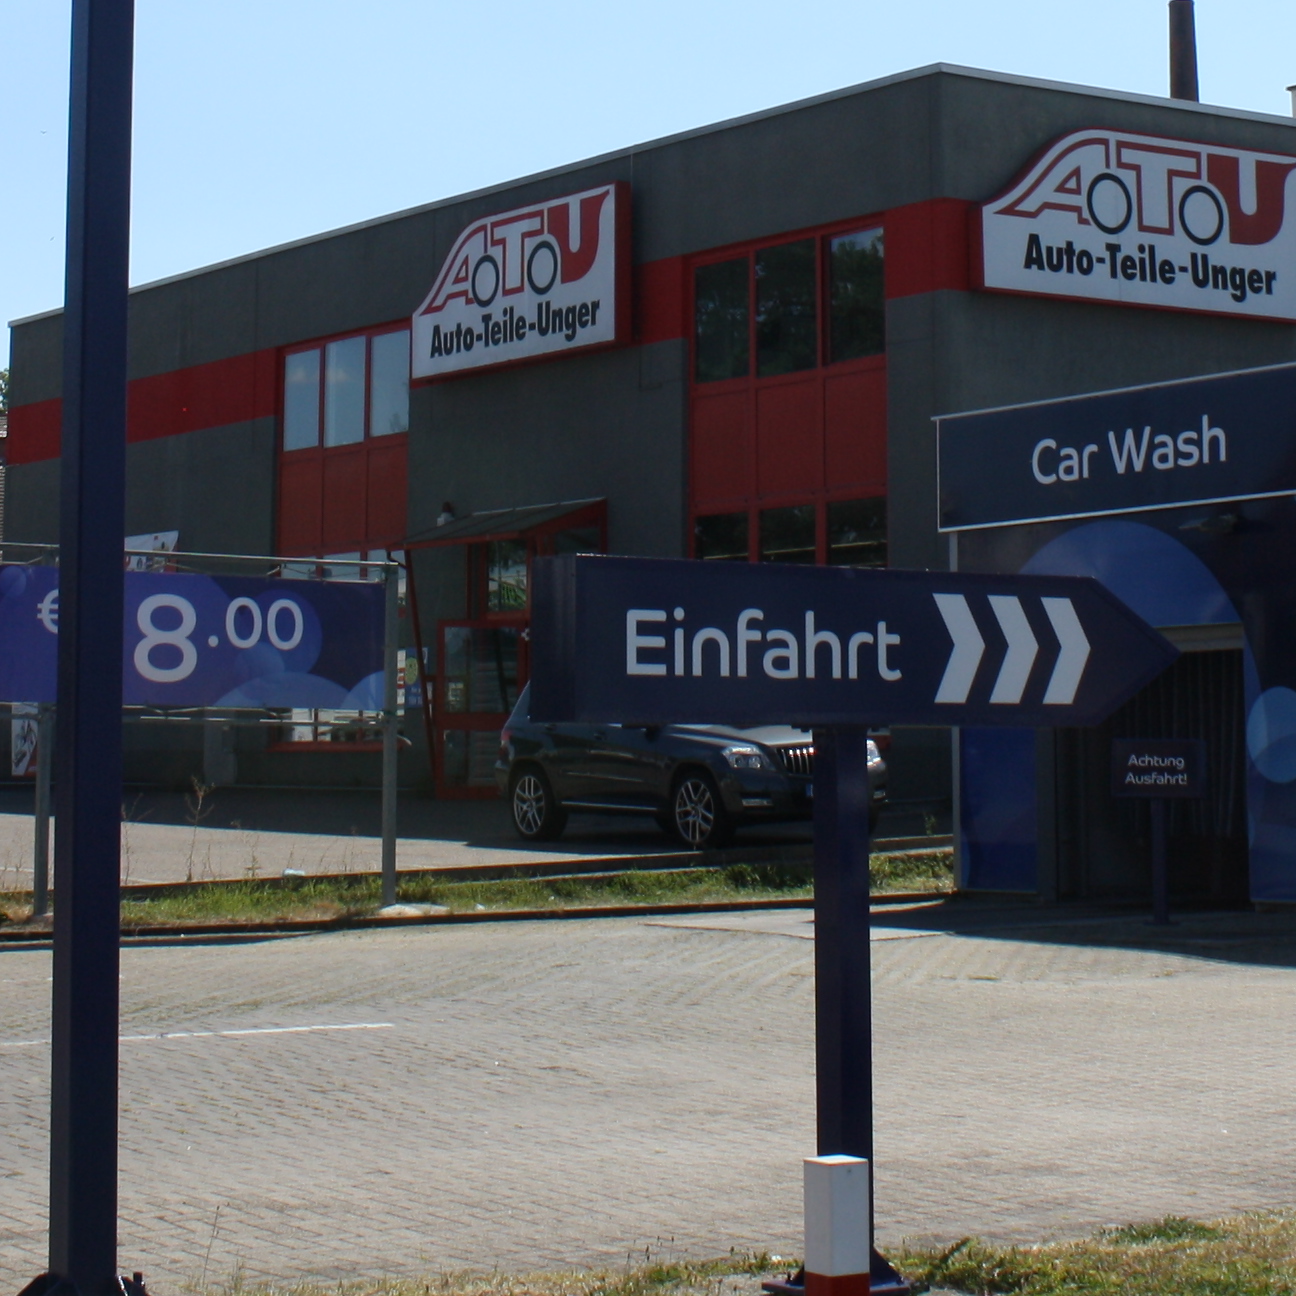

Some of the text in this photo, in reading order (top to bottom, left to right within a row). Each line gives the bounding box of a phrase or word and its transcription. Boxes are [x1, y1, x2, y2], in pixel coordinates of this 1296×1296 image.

[419, 188, 611, 317] ATU
[1023, 233, 1277, 303] Auto-Teile-Unger
[429, 299, 601, 359] Auto-Teile-Unger
[1031, 414, 1227, 485] Car Wash
[133, 593, 305, 683] 8.00
[625, 606, 903, 682] Einfahrt
[1125, 772, 1187, 786] Ausfahrt!
[1128, 754, 1185, 770] Achtung
